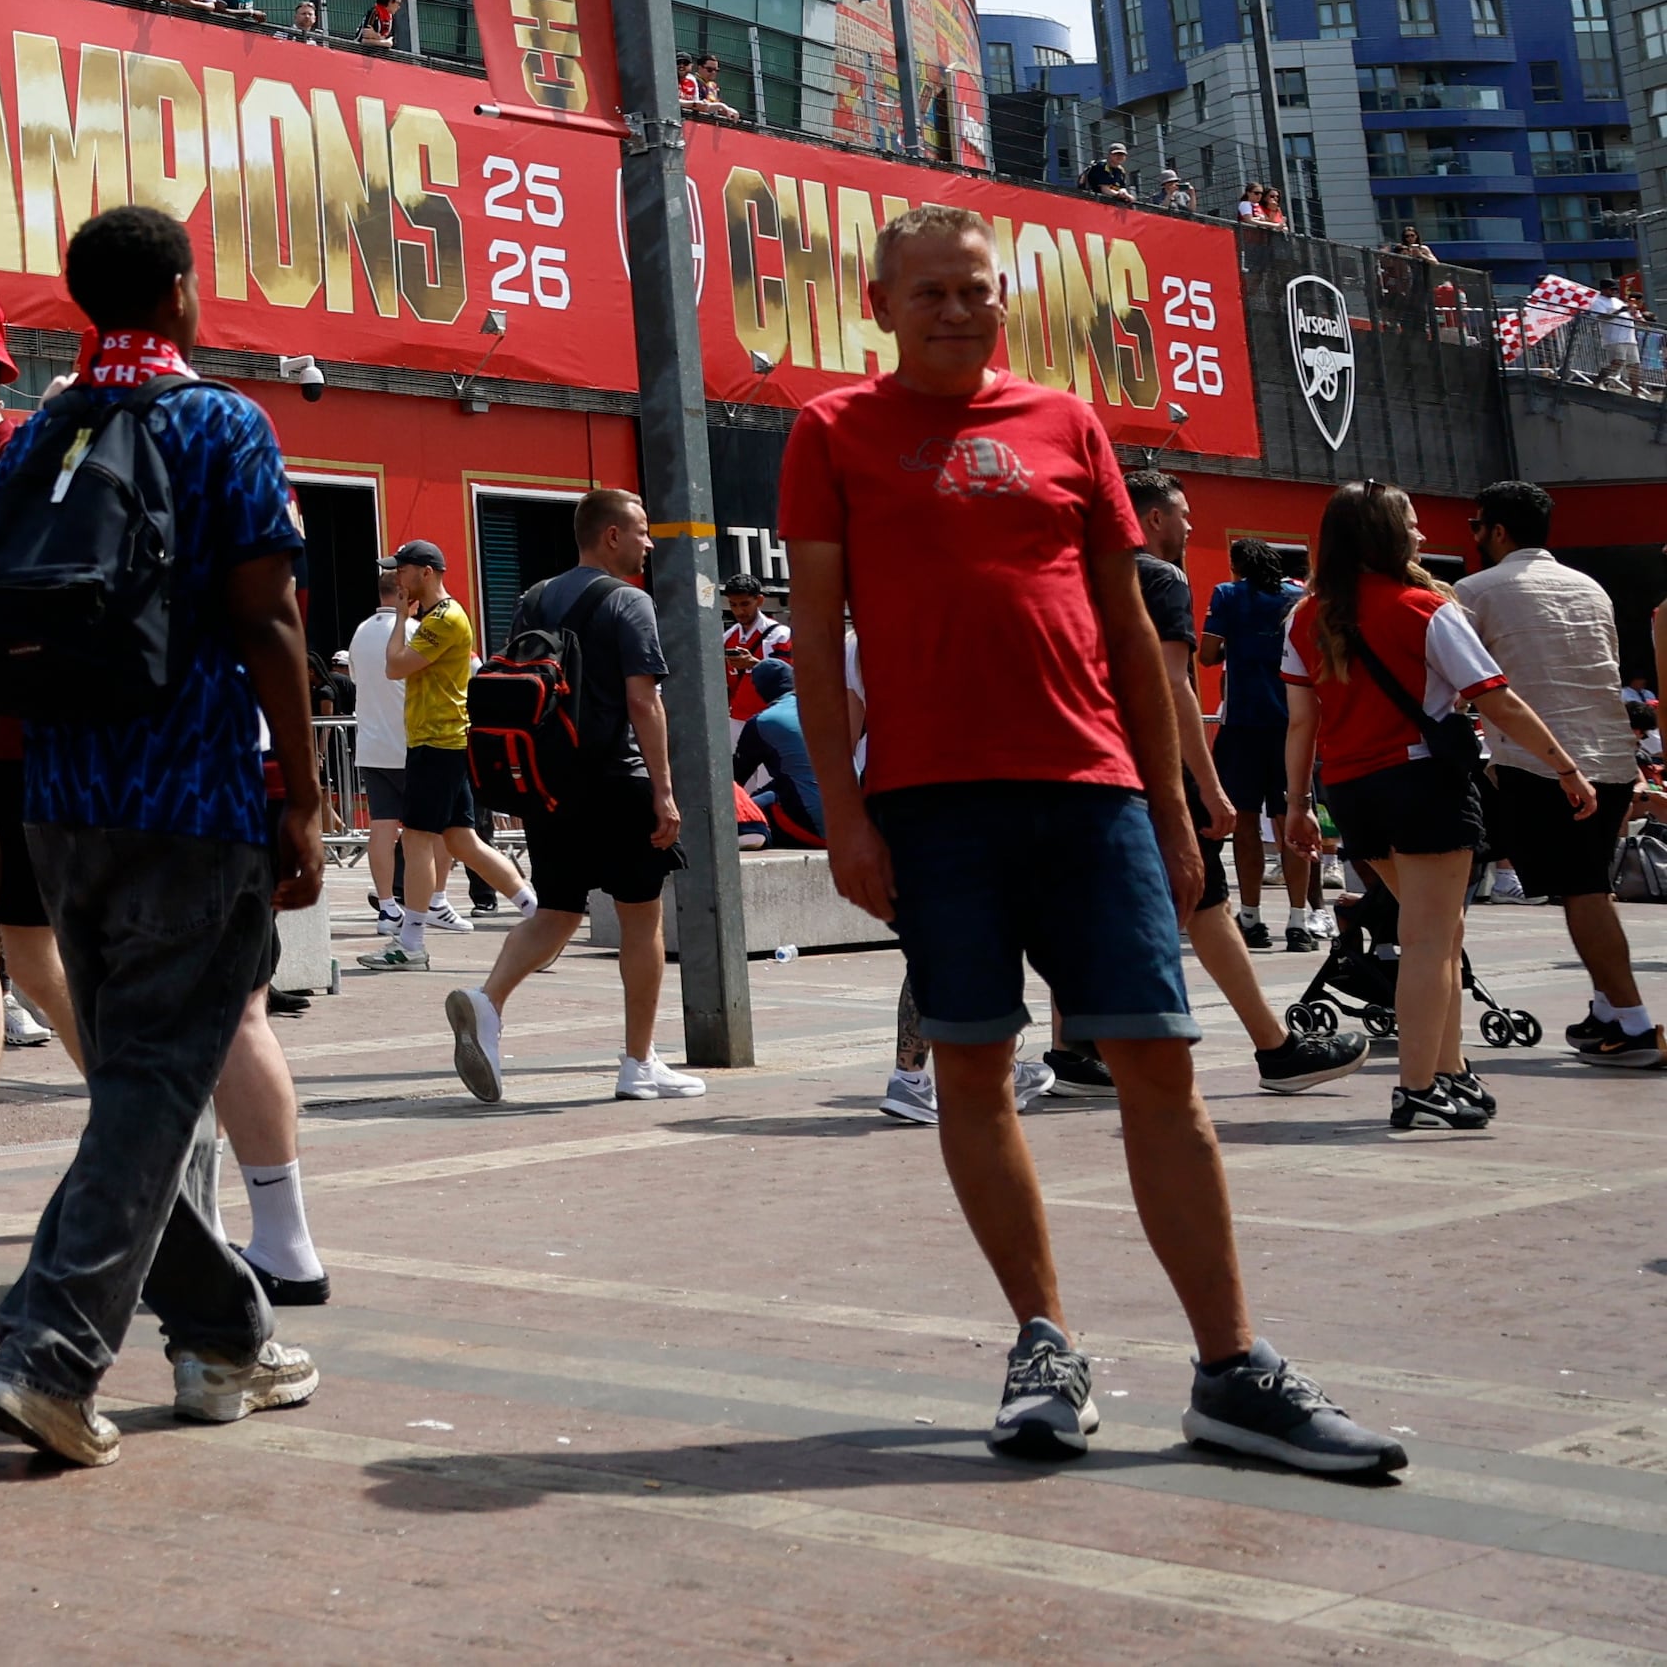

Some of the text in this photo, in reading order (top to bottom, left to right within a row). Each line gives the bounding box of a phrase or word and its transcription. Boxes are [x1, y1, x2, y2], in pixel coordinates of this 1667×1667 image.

[482, 154, 564, 228] 25
[490, 238, 572, 311] 26
[722, 165, 1162, 410] CHAIONS
[1161, 275, 1217, 331] 25
[1297, 307, 1345, 339] Arsenal
[1169, 340, 1225, 397] 26
